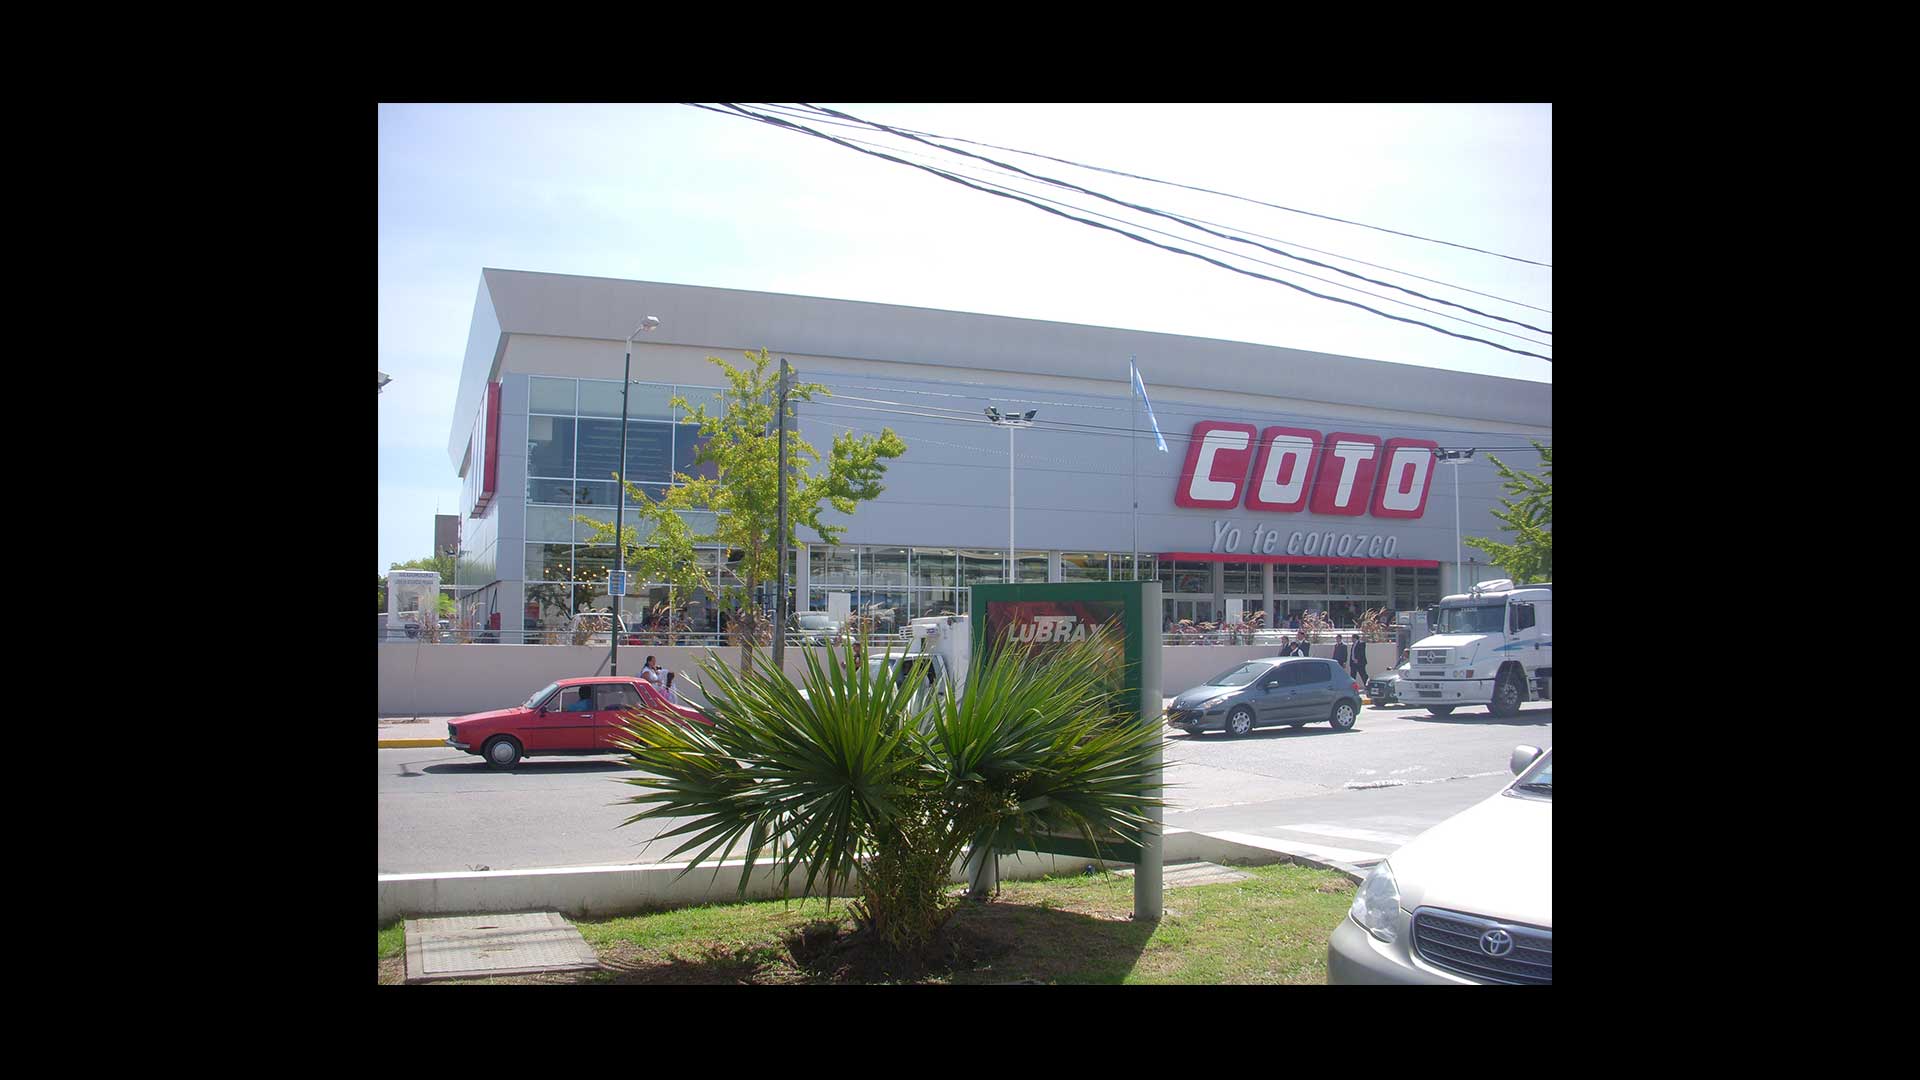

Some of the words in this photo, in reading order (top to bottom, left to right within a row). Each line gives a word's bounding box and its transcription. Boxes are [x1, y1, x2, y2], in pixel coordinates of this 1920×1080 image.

[1188, 429, 1430, 511] COTO
[1211, 520, 1241, 553] Yo
[1251, 522, 1278, 554] te
